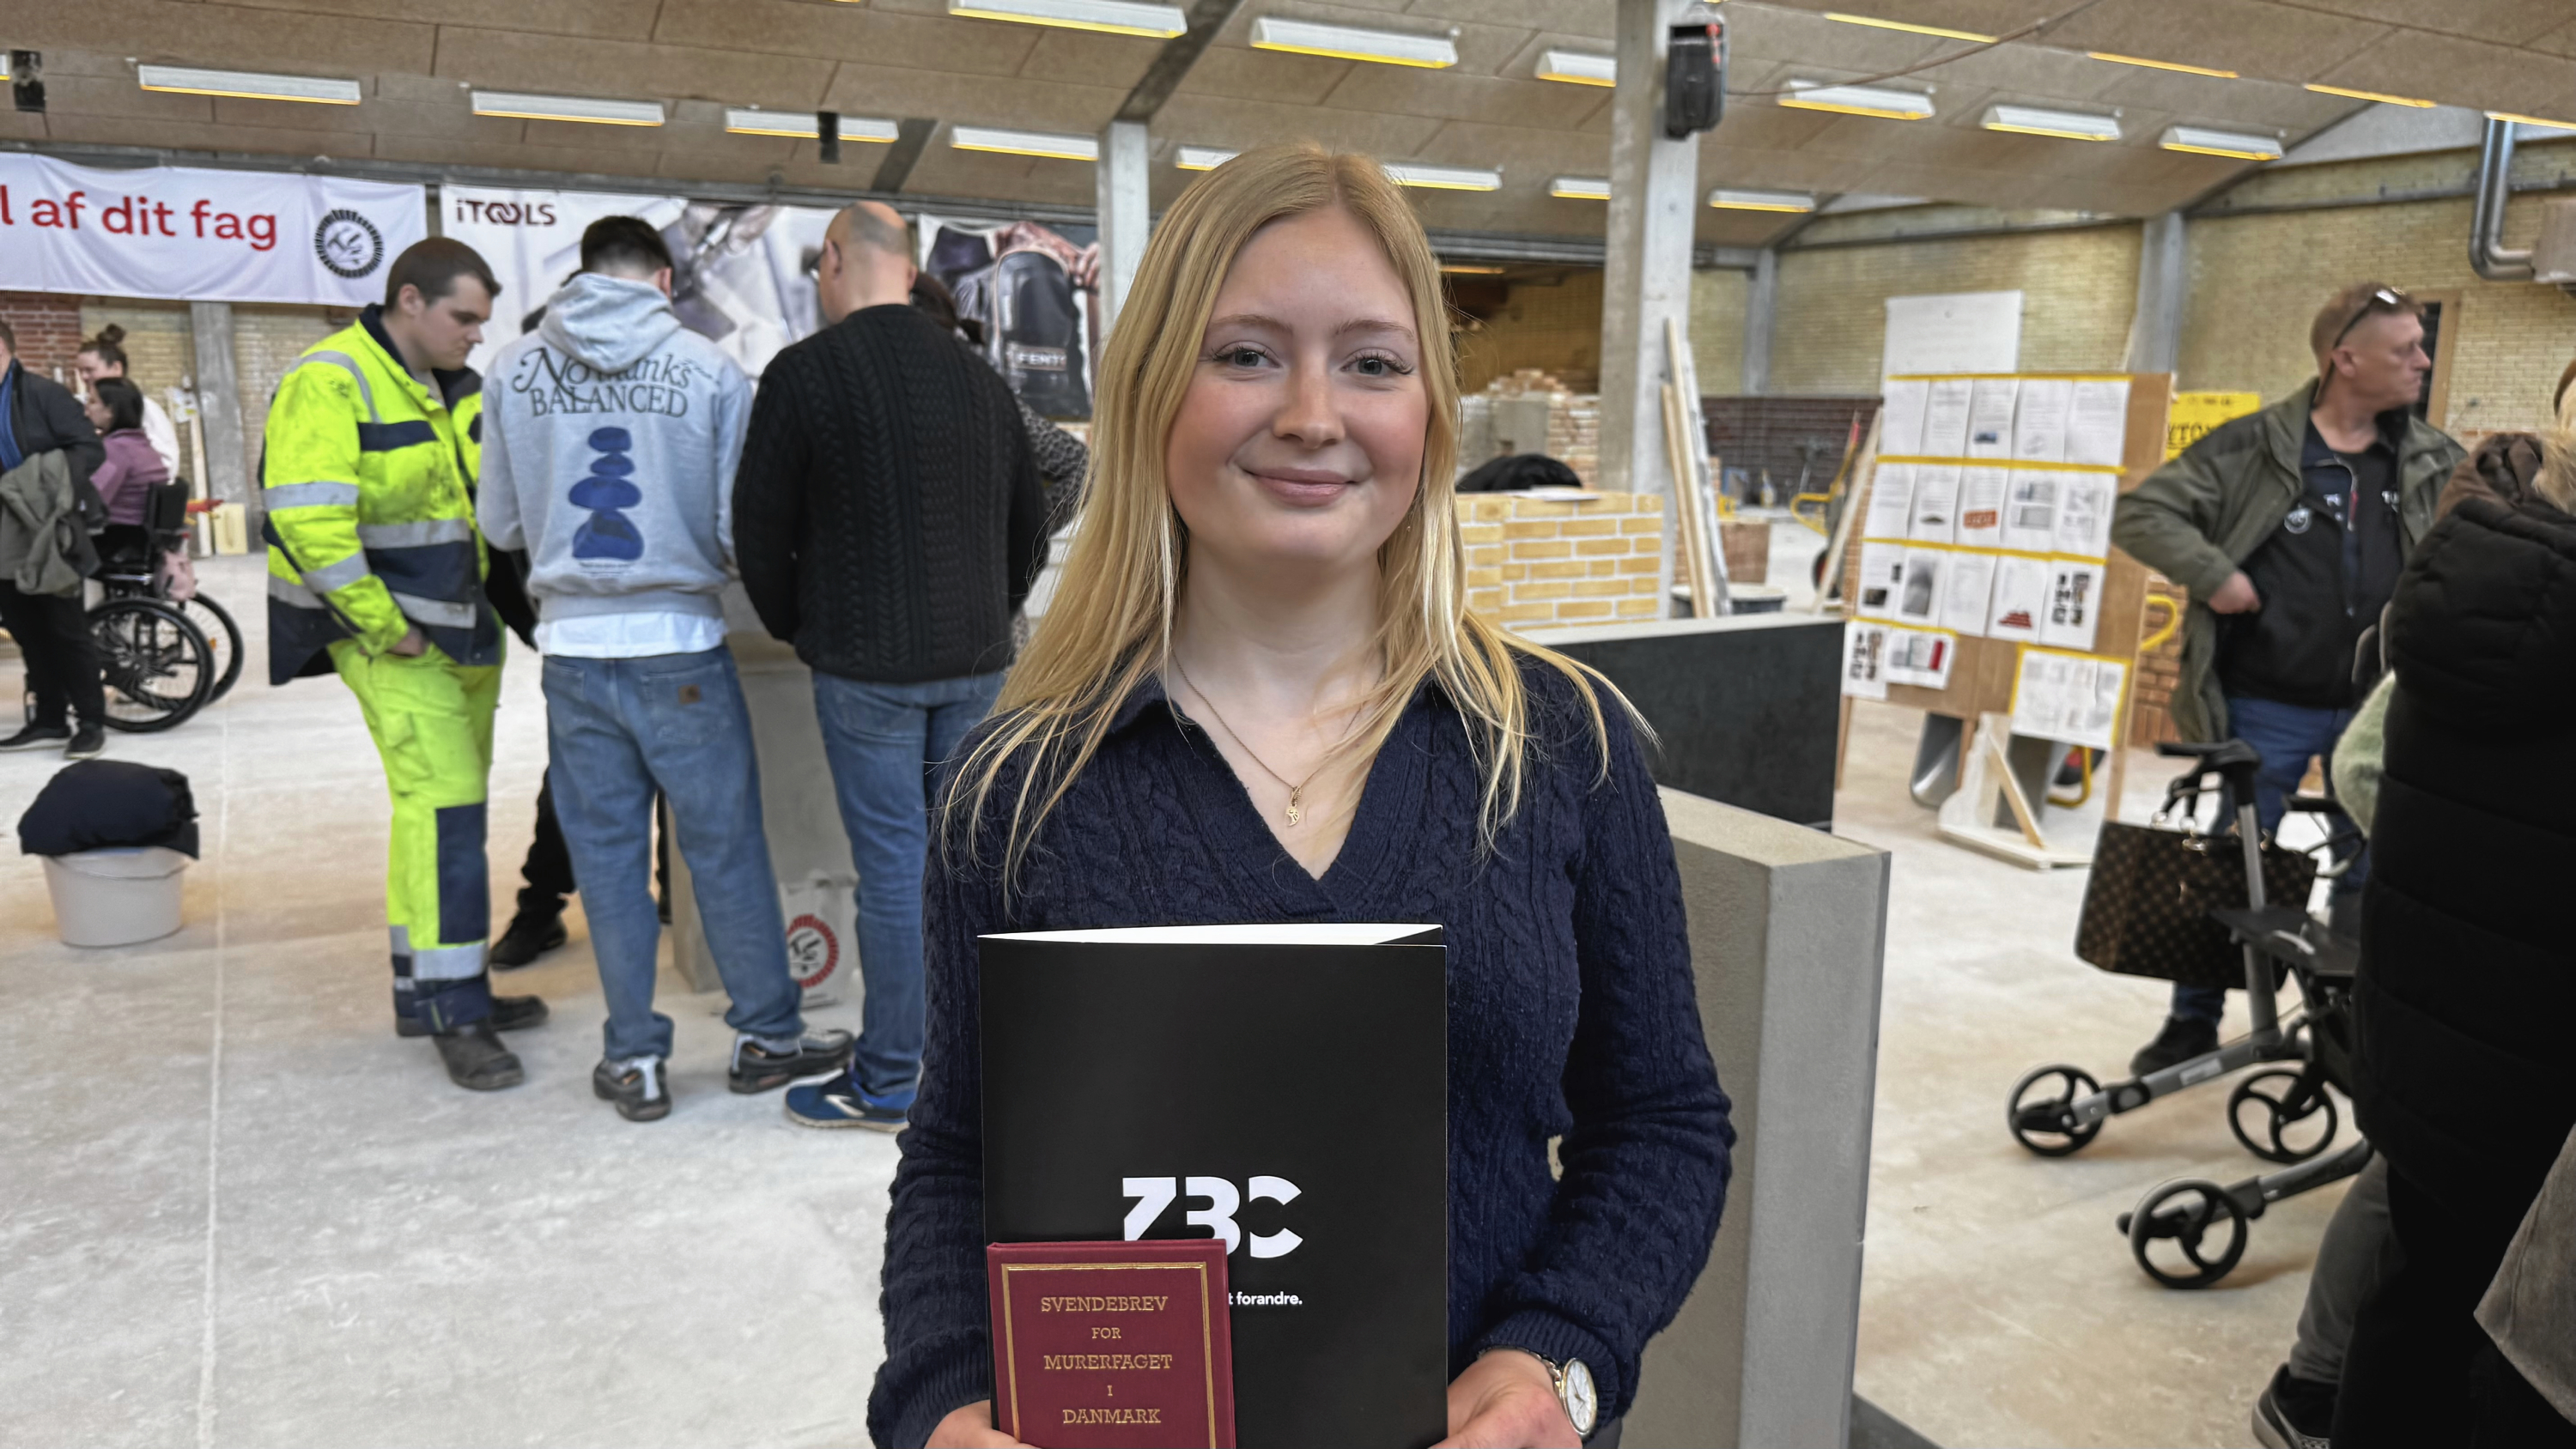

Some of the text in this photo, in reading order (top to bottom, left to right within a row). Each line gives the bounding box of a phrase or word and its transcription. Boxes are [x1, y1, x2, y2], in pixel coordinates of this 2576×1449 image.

[31, 191, 87, 229] af
[101, 196, 177, 237] dit
[190, 200, 276, 252] fag
[513, 347, 592, 403] No
[530, 384, 689, 419] BALANCED
[1122, 1175, 1303, 1258] ZBC
[1041, 1296, 1169, 1312] SVENDEBREV
[1236, 1291, 1303, 1306] forandre.
[1091, 1327, 1121, 1339] FOR
[1043, 1355, 1172, 1370] MURERFAGET
[1107, 1385, 1113, 1397] I
[1062, 1409, 1162, 1424] DANMARK
